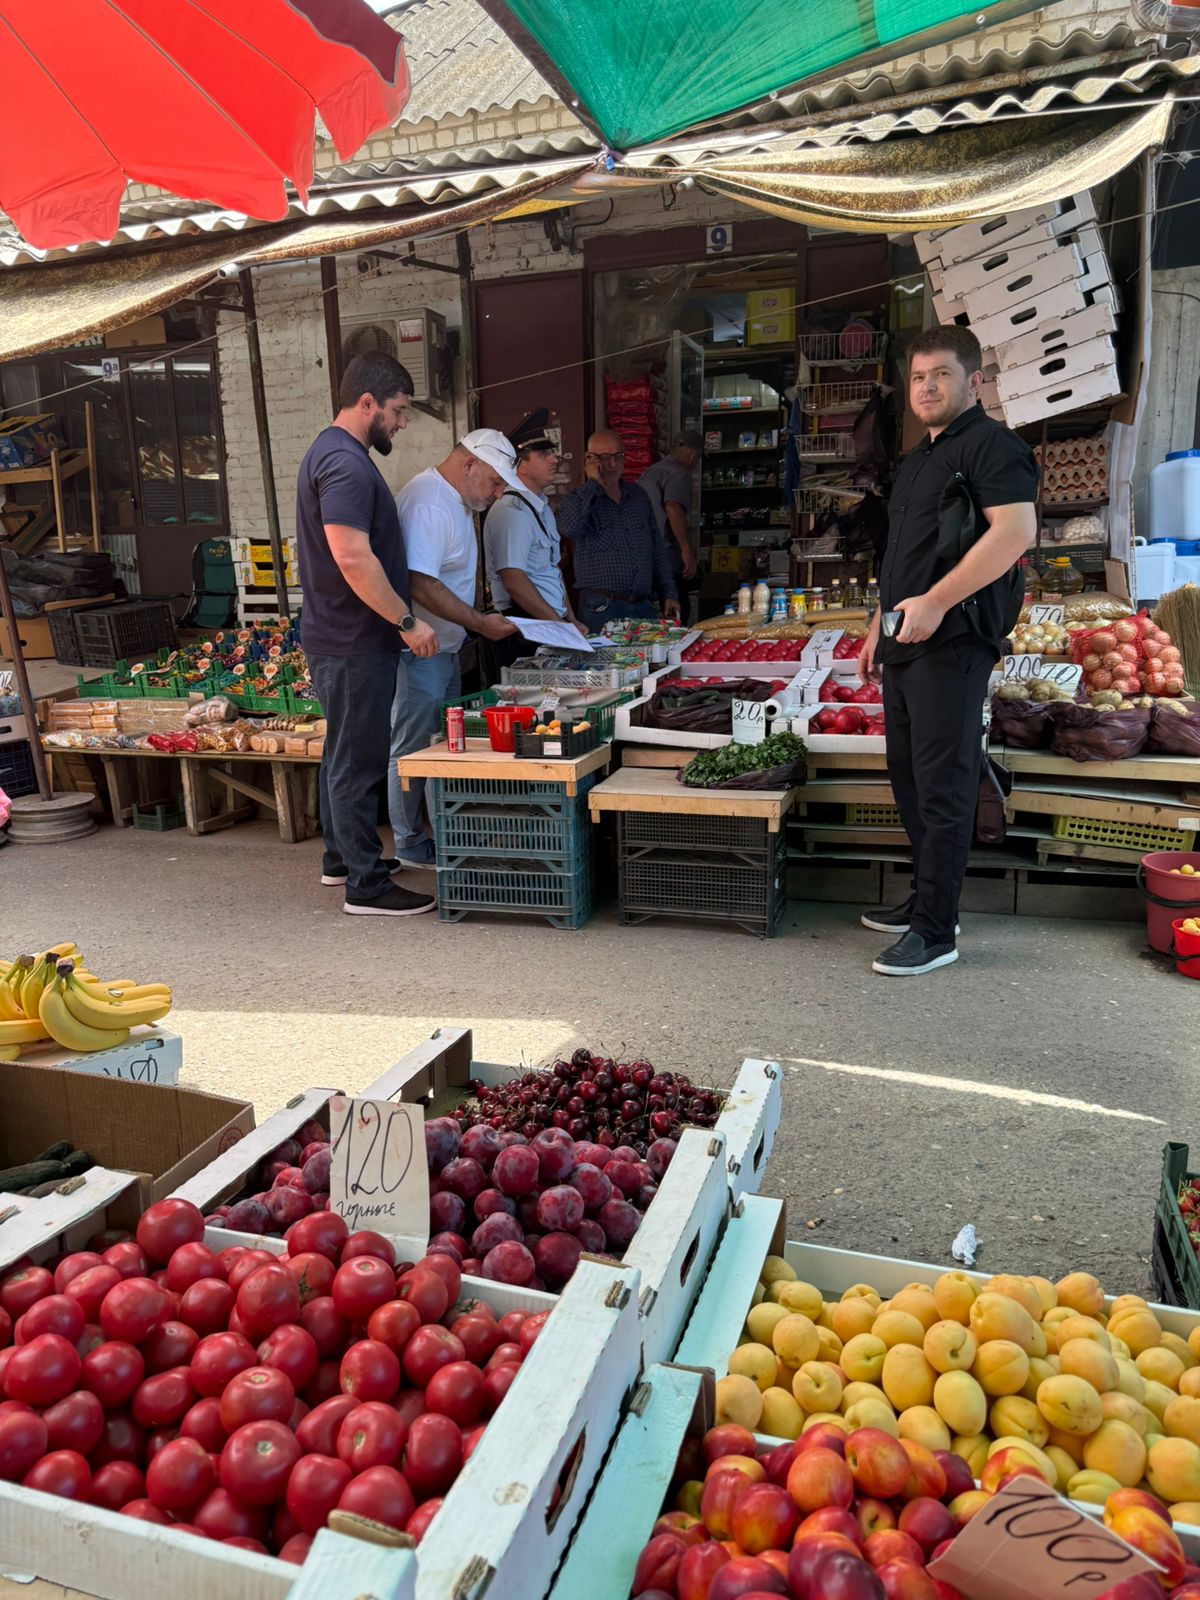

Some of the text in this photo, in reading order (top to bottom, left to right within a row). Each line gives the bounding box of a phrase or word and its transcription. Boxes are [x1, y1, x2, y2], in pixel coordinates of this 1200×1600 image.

[711, 227, 727, 252] 9
[1036, 606, 1062, 625] 70
[1005, 656, 1041, 680] 200
[1043, 664, 1078, 685] 70
[332, 1099, 414, 1200] 120
[984, 1491, 1134, 1564] 100
